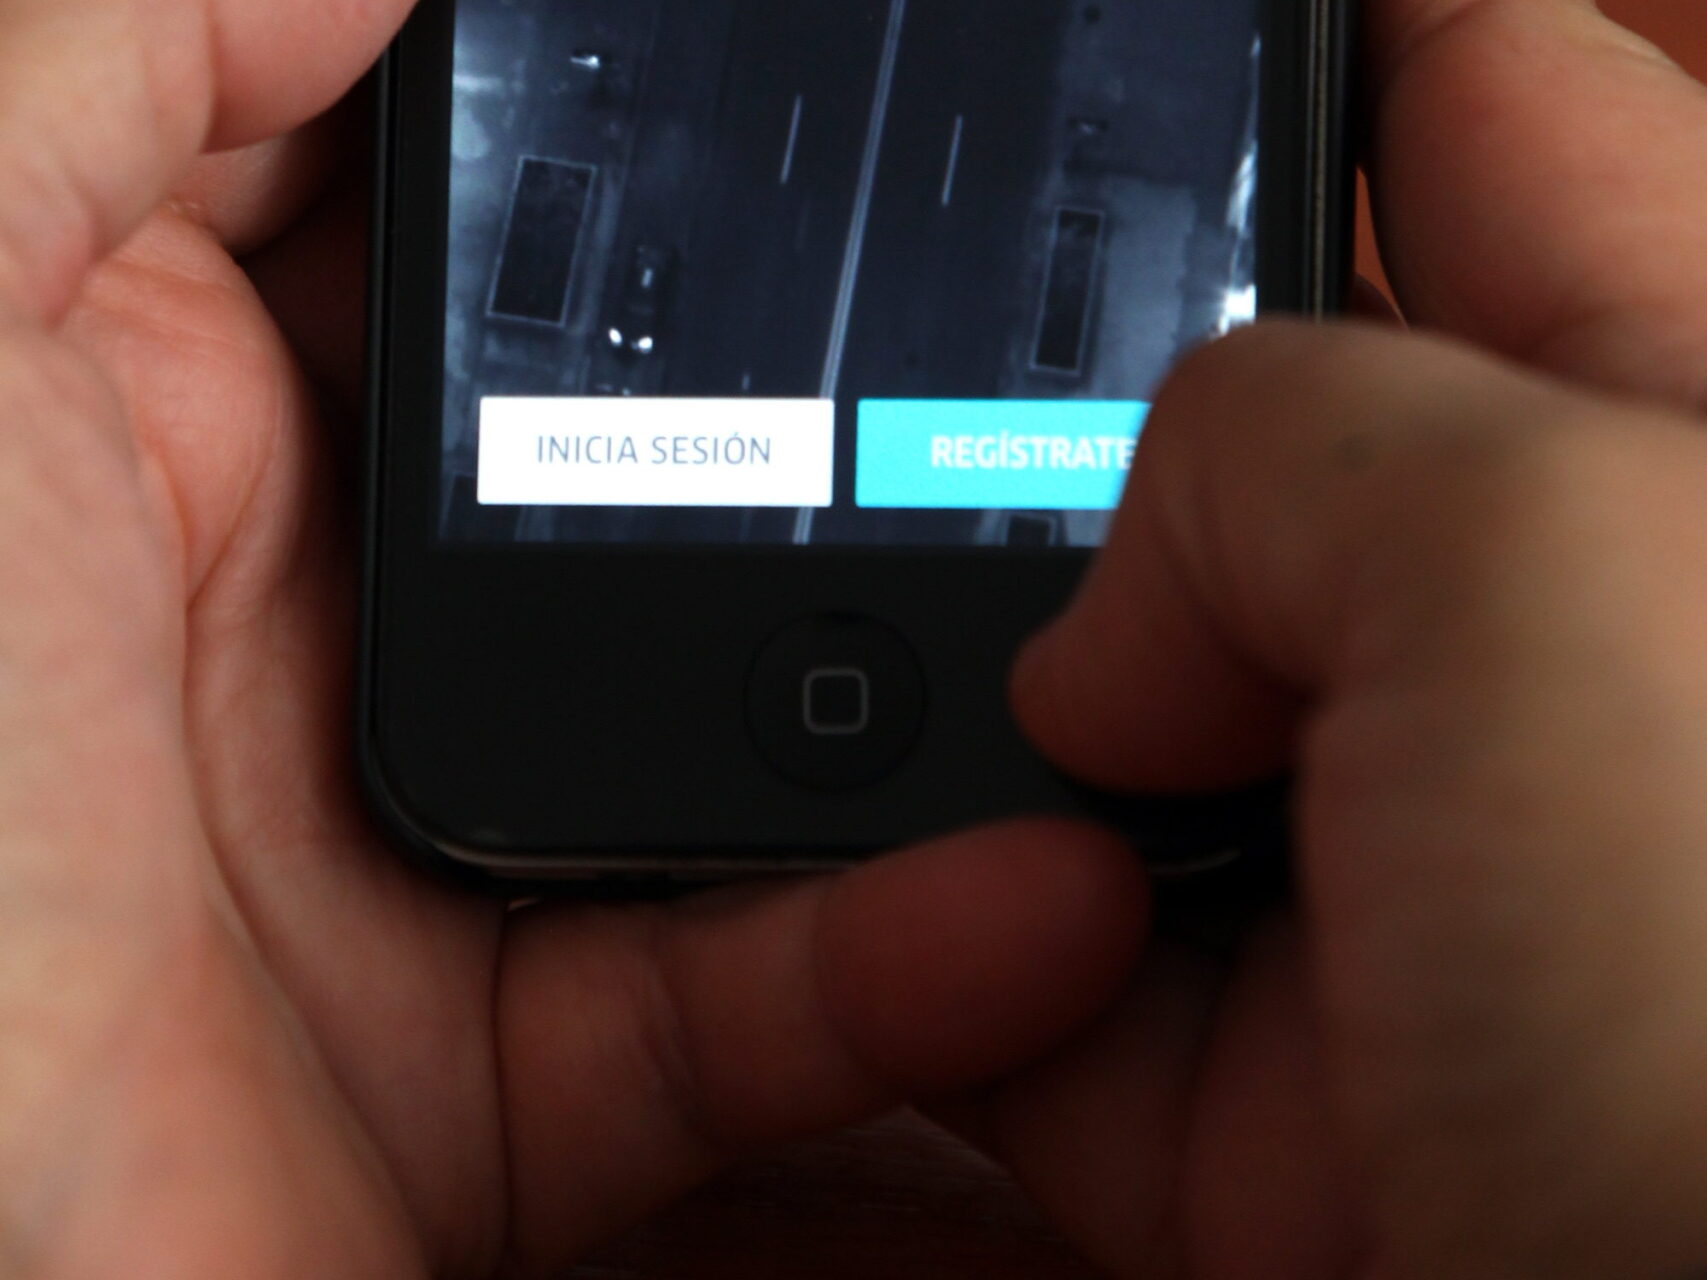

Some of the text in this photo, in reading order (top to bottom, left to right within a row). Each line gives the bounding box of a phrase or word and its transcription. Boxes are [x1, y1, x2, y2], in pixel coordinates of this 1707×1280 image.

[536, 431, 772, 466] INICIA SESIÓN
[929, 429, 1138, 470] REGÍSTRATE
